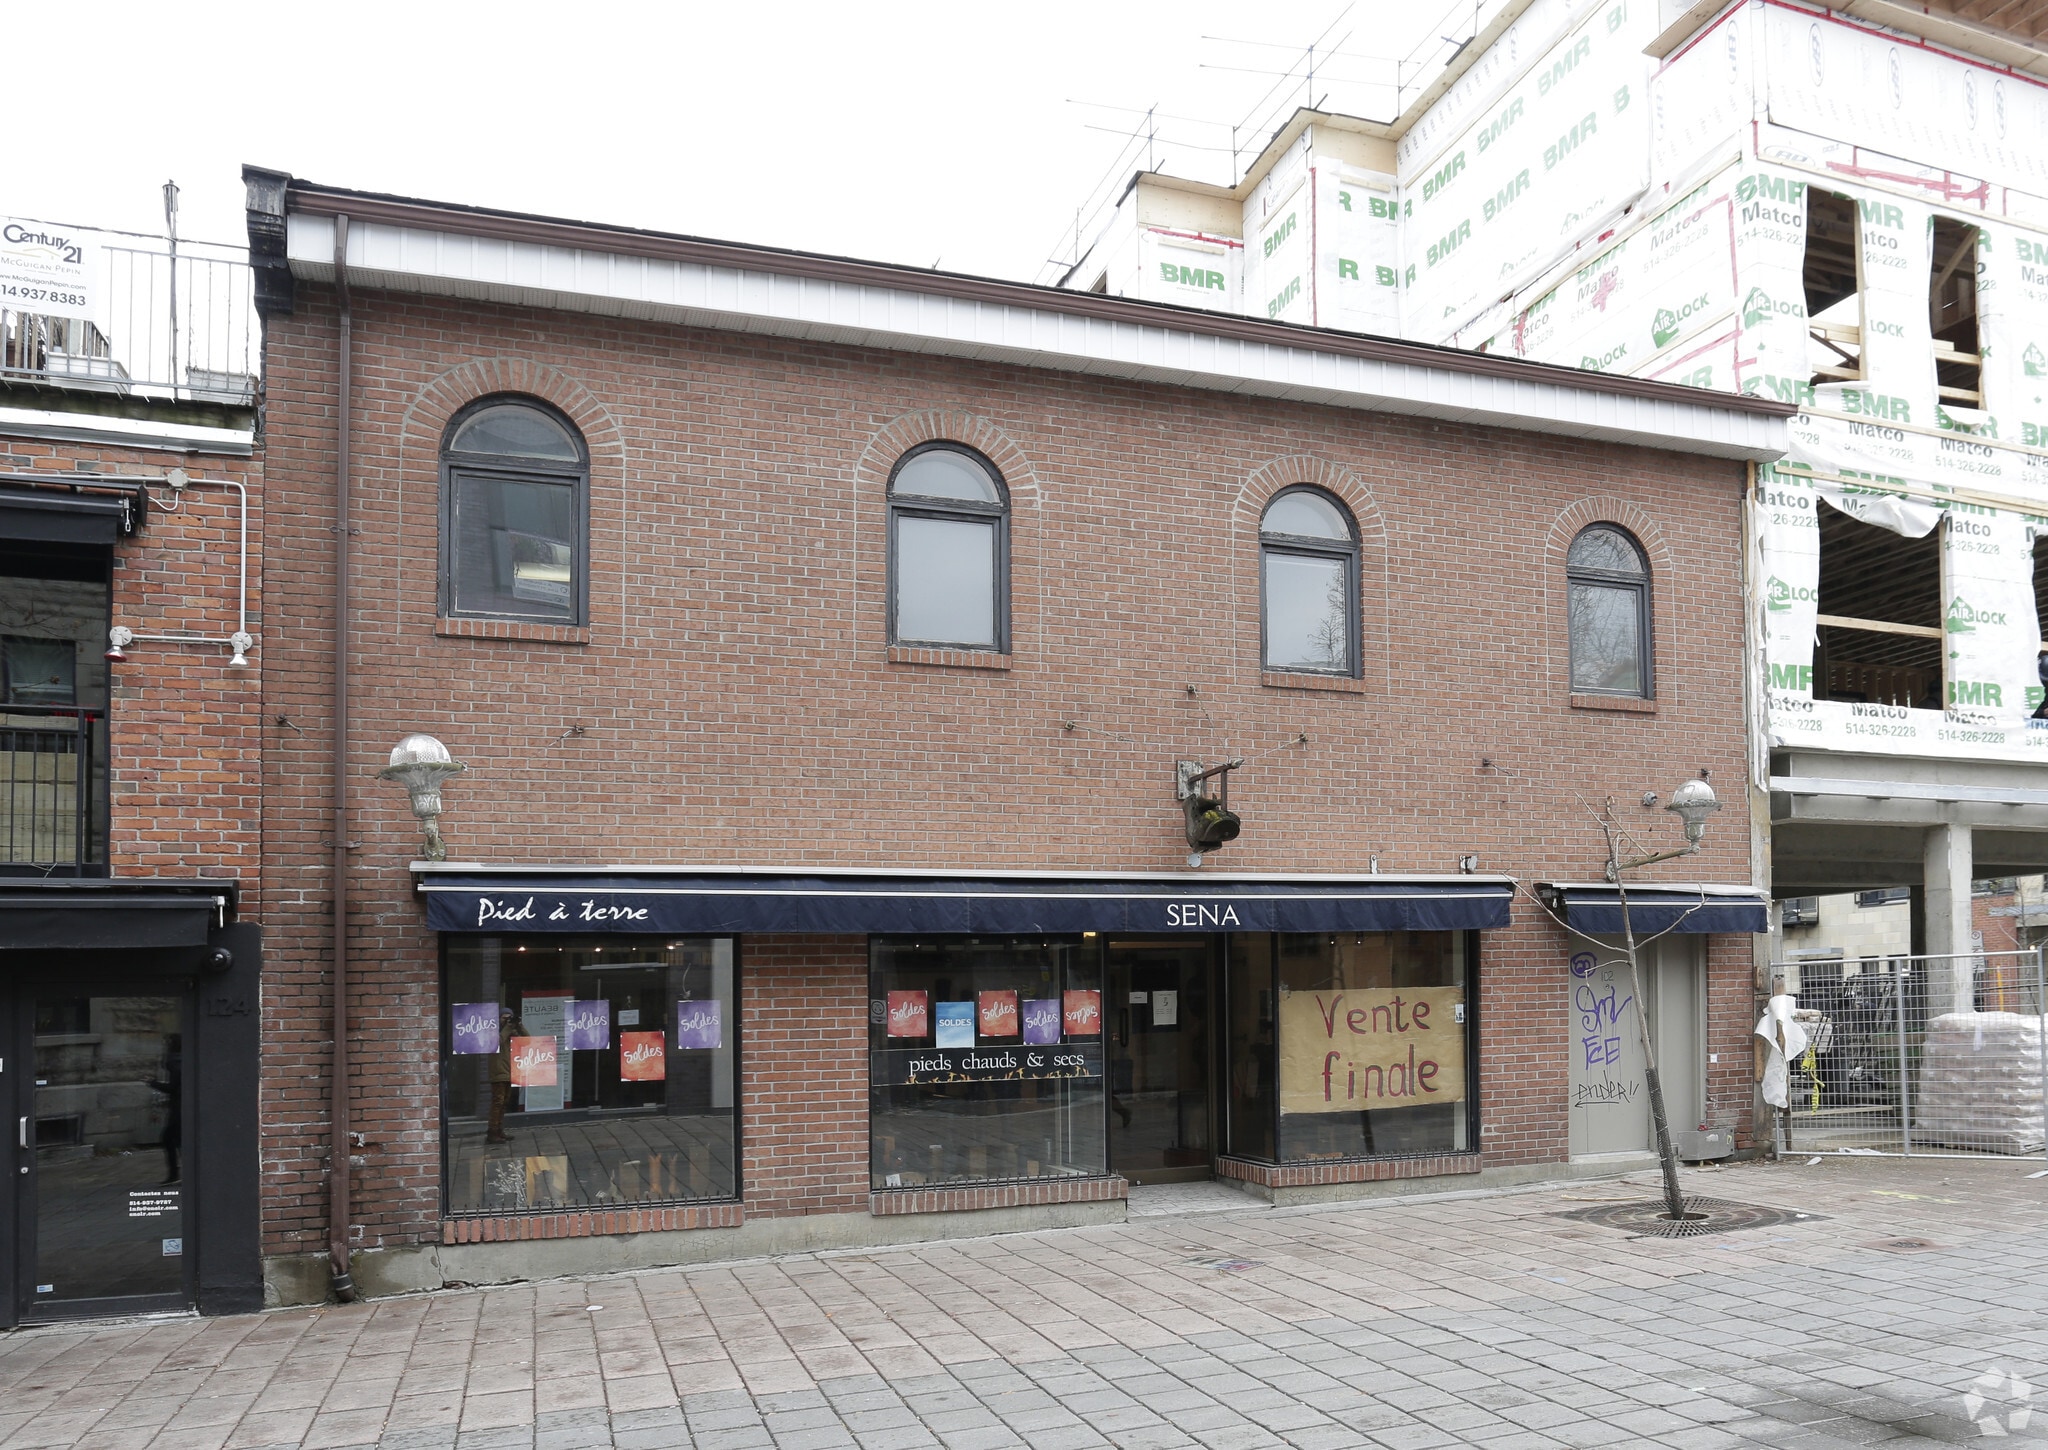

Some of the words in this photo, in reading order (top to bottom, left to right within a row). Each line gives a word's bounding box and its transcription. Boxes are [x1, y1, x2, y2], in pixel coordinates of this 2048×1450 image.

[1538, 34, 1591, 98] BMR
[1477, 96, 1525, 154] BMR
[1543, 111, 1598, 172] BMR
[1422, 150, 1466, 203] BMR
[1482, 168, 1531, 223] BMR
[1650, 209, 1701, 251] Matco
[1742, 201, 1802, 228] Matco
[3, 224, 70, 250] Century
[1264, 212, 1297, 261] BMR
[1426, 218, 1471, 269] BMR
[63, 245, 82, 264] 21
[1160, 262, 1226, 292] BMR
[1268, 275, 1301, 319] BMR
[1841, 387, 1911, 424] BMR
[1851, 702, 1908, 719] Matco
[1944, 709, 1998, 726] Matco
[1845, 722, 1917, 738] 514-326-2228
[1937, 729, 2006, 744] 514-326-2228
[477, 896, 537, 927] Pied
[549, 902, 571, 921] à
[579, 898, 649, 922] terre
[1166, 903, 1241, 927] SENA
[938, 1018, 972, 1027] SOLDES
[1315, 993, 1431, 1039] Vente
[908, 1053, 952, 1077] pieds
[961, 1051, 1017, 1070] chauds
[1026, 1052, 1044, 1067] &
[1053, 1053, 1084, 1067] secs
[1321, 1043, 1439, 1102] finale
